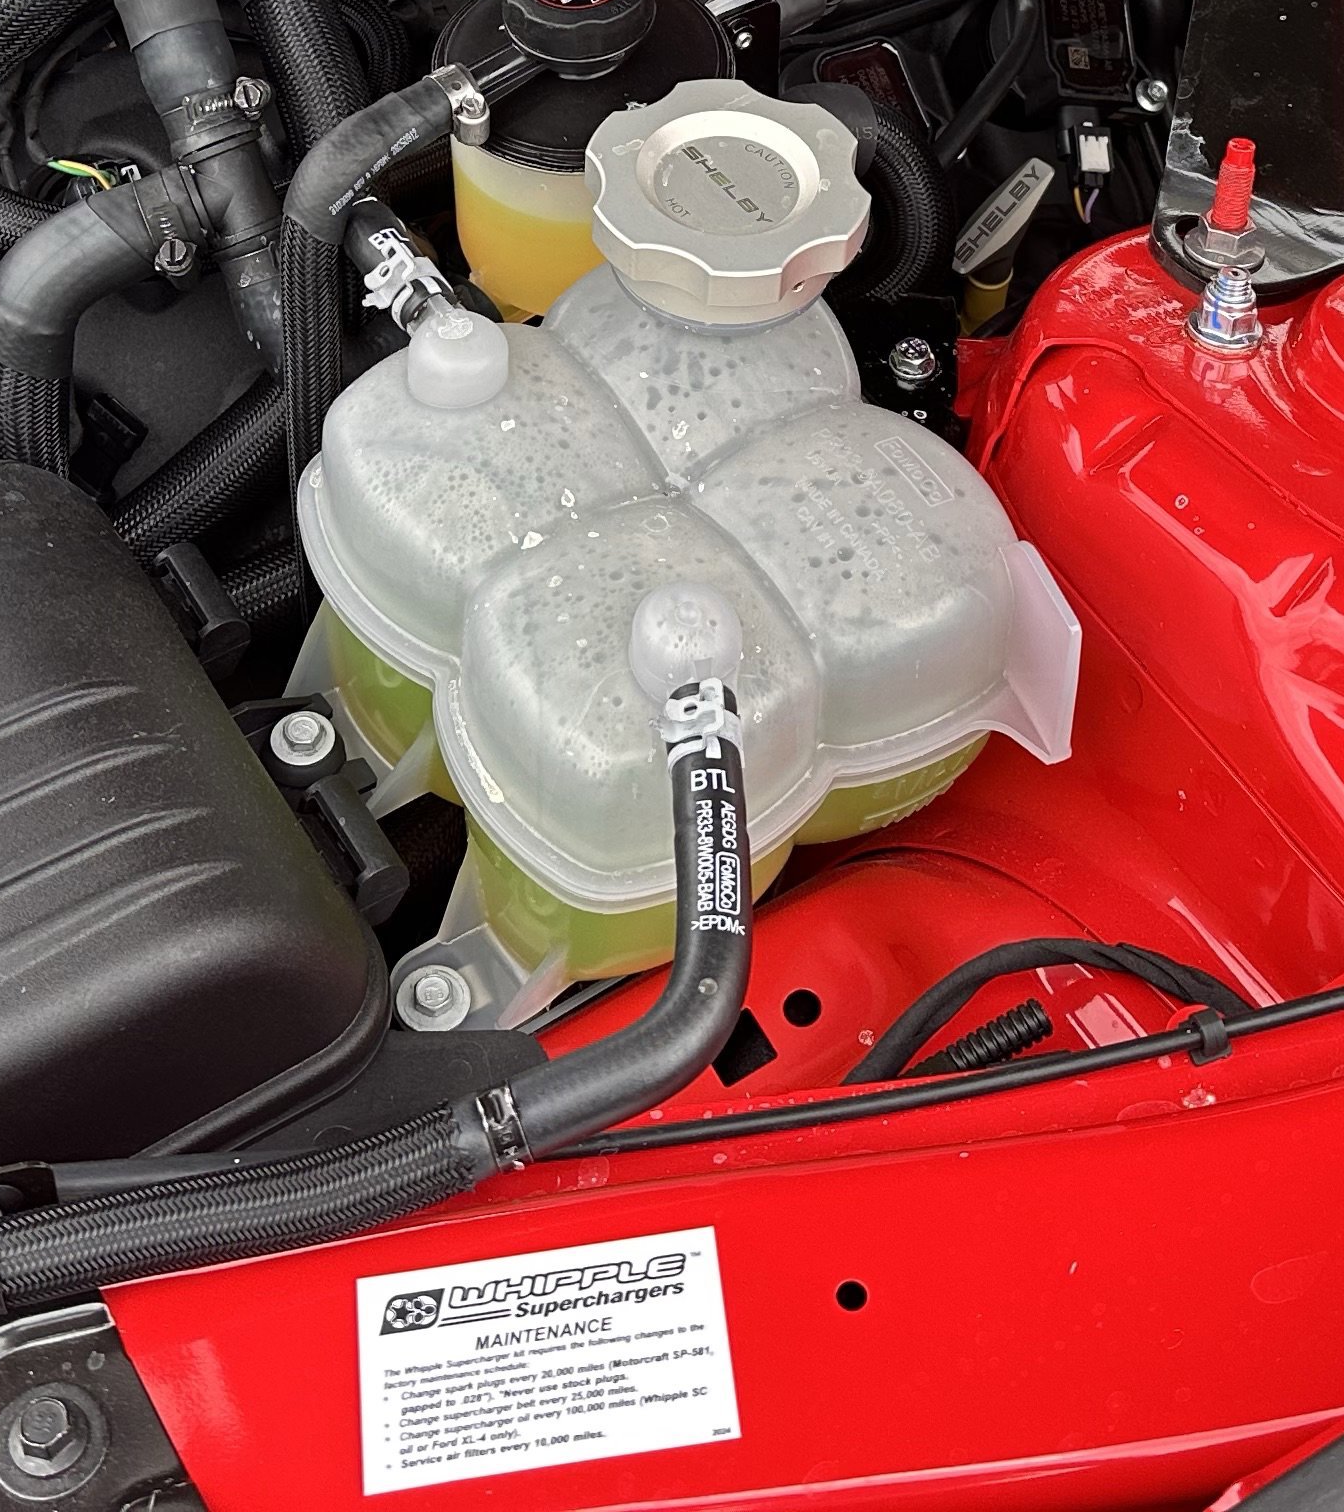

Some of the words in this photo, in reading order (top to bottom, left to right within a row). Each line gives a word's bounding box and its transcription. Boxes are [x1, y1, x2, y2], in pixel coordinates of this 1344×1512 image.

[681, 145, 774, 223] SHELBY
[744, 143, 796, 189] CAUTION
[665, 197, 691, 219] HOT
[955, 165, 1040, 265] SHELBY
[690, 768, 736, 794] BTL
[720, 856, 736, 909] FoMoCo
[690, 914, 746, 936] >EPDM<
[447, 1251, 688, 1310] WHIPPLE
[514, 1278, 685, 1321] Superchargers
[384, 1367, 400, 1377] The
[446, 1351, 510, 1369] Supercharger
[570, 1340, 584, 1349] the
[587, 1333, 631, 1348] following
[634, 1328, 674, 1341] changes
[689, 1323, 704, 1331] the
[474, 1316, 614, 1351] MAINTENANCE
[401, 1386, 441, 1402] Change
[445, 1382, 472, 1394] spark
[476, 1377, 505, 1390] plugs
[509, 1373, 537, 1385] every
[577, 1361, 604, 1373] miles
[608, 1352, 669, 1370] (Motorcraft
[401, 1400, 442, 1415] gapped
[538, 1383, 557, 1392] use
[561, 1377, 591, 1389] stock
[399, 1413, 439, 1429] Change
[443, 1402, 513, 1422] supercharger
[516, 1399, 535, 1409] belt
[539, 1395, 567, 1407] every
[607, 1383, 638, 1395] miles.
[400, 1426, 440, 1442] Change
[443, 1415, 513, 1436] supercharger
[517, 1412, 530, 1422] oil
[533, 1410, 561, 1421] every
[608, 1397, 635, 1409] miles
[639, 1389, 688, 1406] (Whipple
[691, 1386, 708, 1396] SC
[399, 1444, 413, 1454] oil
[432, 1437, 457, 1449] Ford
[461, 1433, 486, 1444] XL-4
[401, 1453, 442, 1468] Service
[446, 1451, 460, 1460] air
[464, 1445, 496, 1458] filters
[500, 1441, 530, 1454] every
[572, 1428, 606, 1441] miles.
